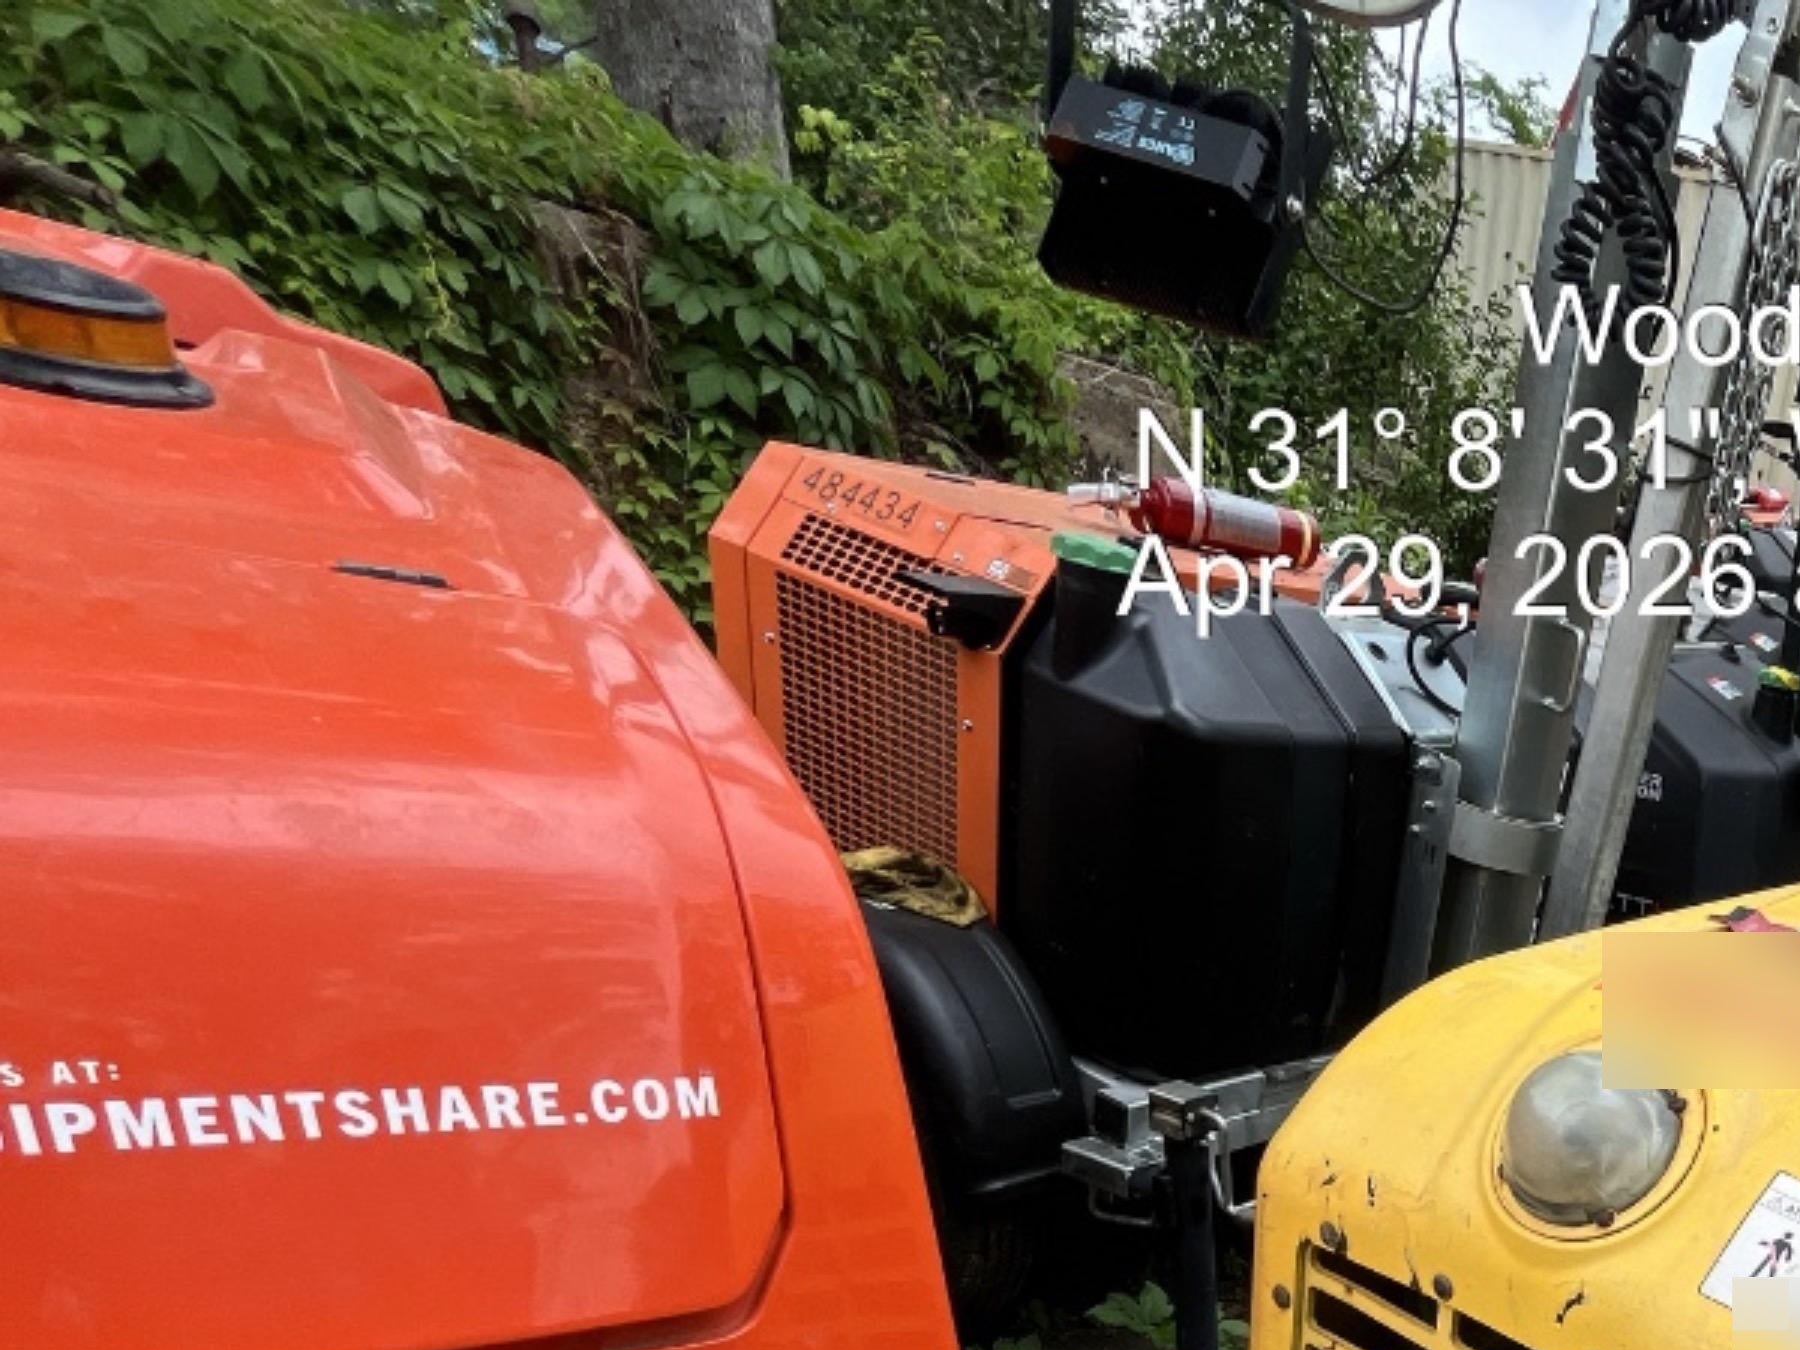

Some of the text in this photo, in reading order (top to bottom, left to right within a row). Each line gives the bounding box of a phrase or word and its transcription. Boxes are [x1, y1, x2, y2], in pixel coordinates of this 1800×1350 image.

[803, 467, 921, 529] 484434
[52, 1061, 120, 1085] AT:
[0, 1074, 720, 1156] IPMENTSHARE.COM
